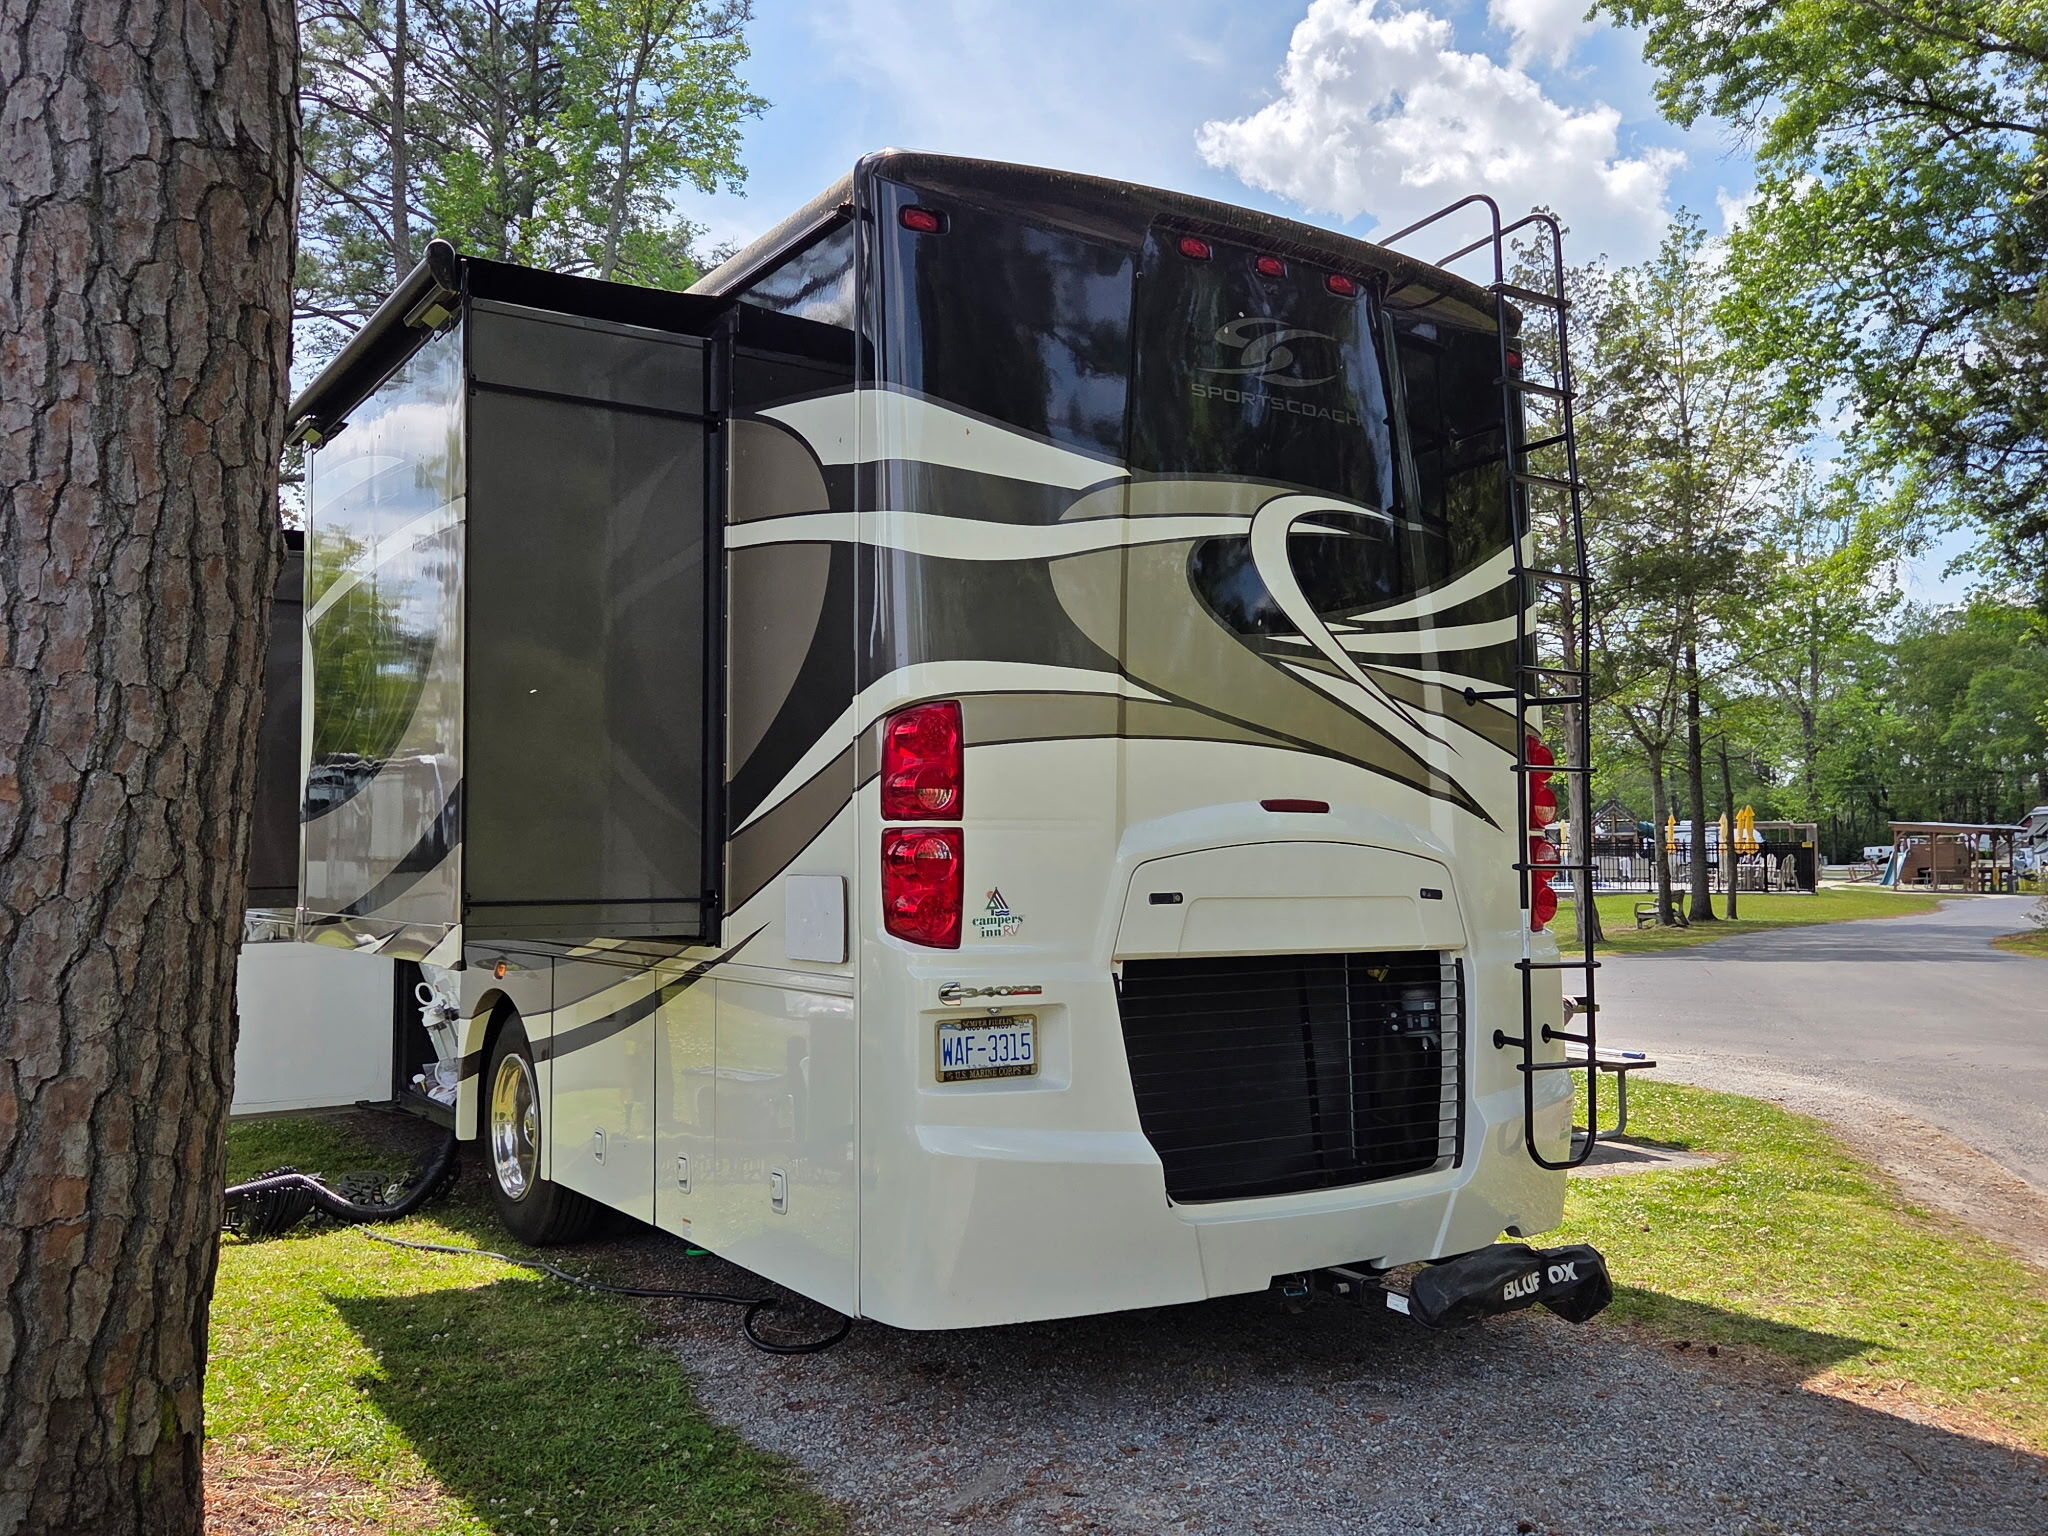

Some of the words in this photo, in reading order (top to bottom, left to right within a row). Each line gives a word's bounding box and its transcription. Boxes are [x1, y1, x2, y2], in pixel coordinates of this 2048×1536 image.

[1191, 383, 1361, 426] SPORTSCOACH
[972, 915, 1023, 928] campers
[981, 927, 1001, 938] inn
[1003, 924, 1020, 937] RV
[942, 1032, 1031, 1067] WAF-3315
[955, 1071, 968, 1080] U.S.
[969, 1068, 997, 1079] MARINE
[998, 1066, 1021, 1077] CORPS
[1548, 1261, 1579, 1285] OX
